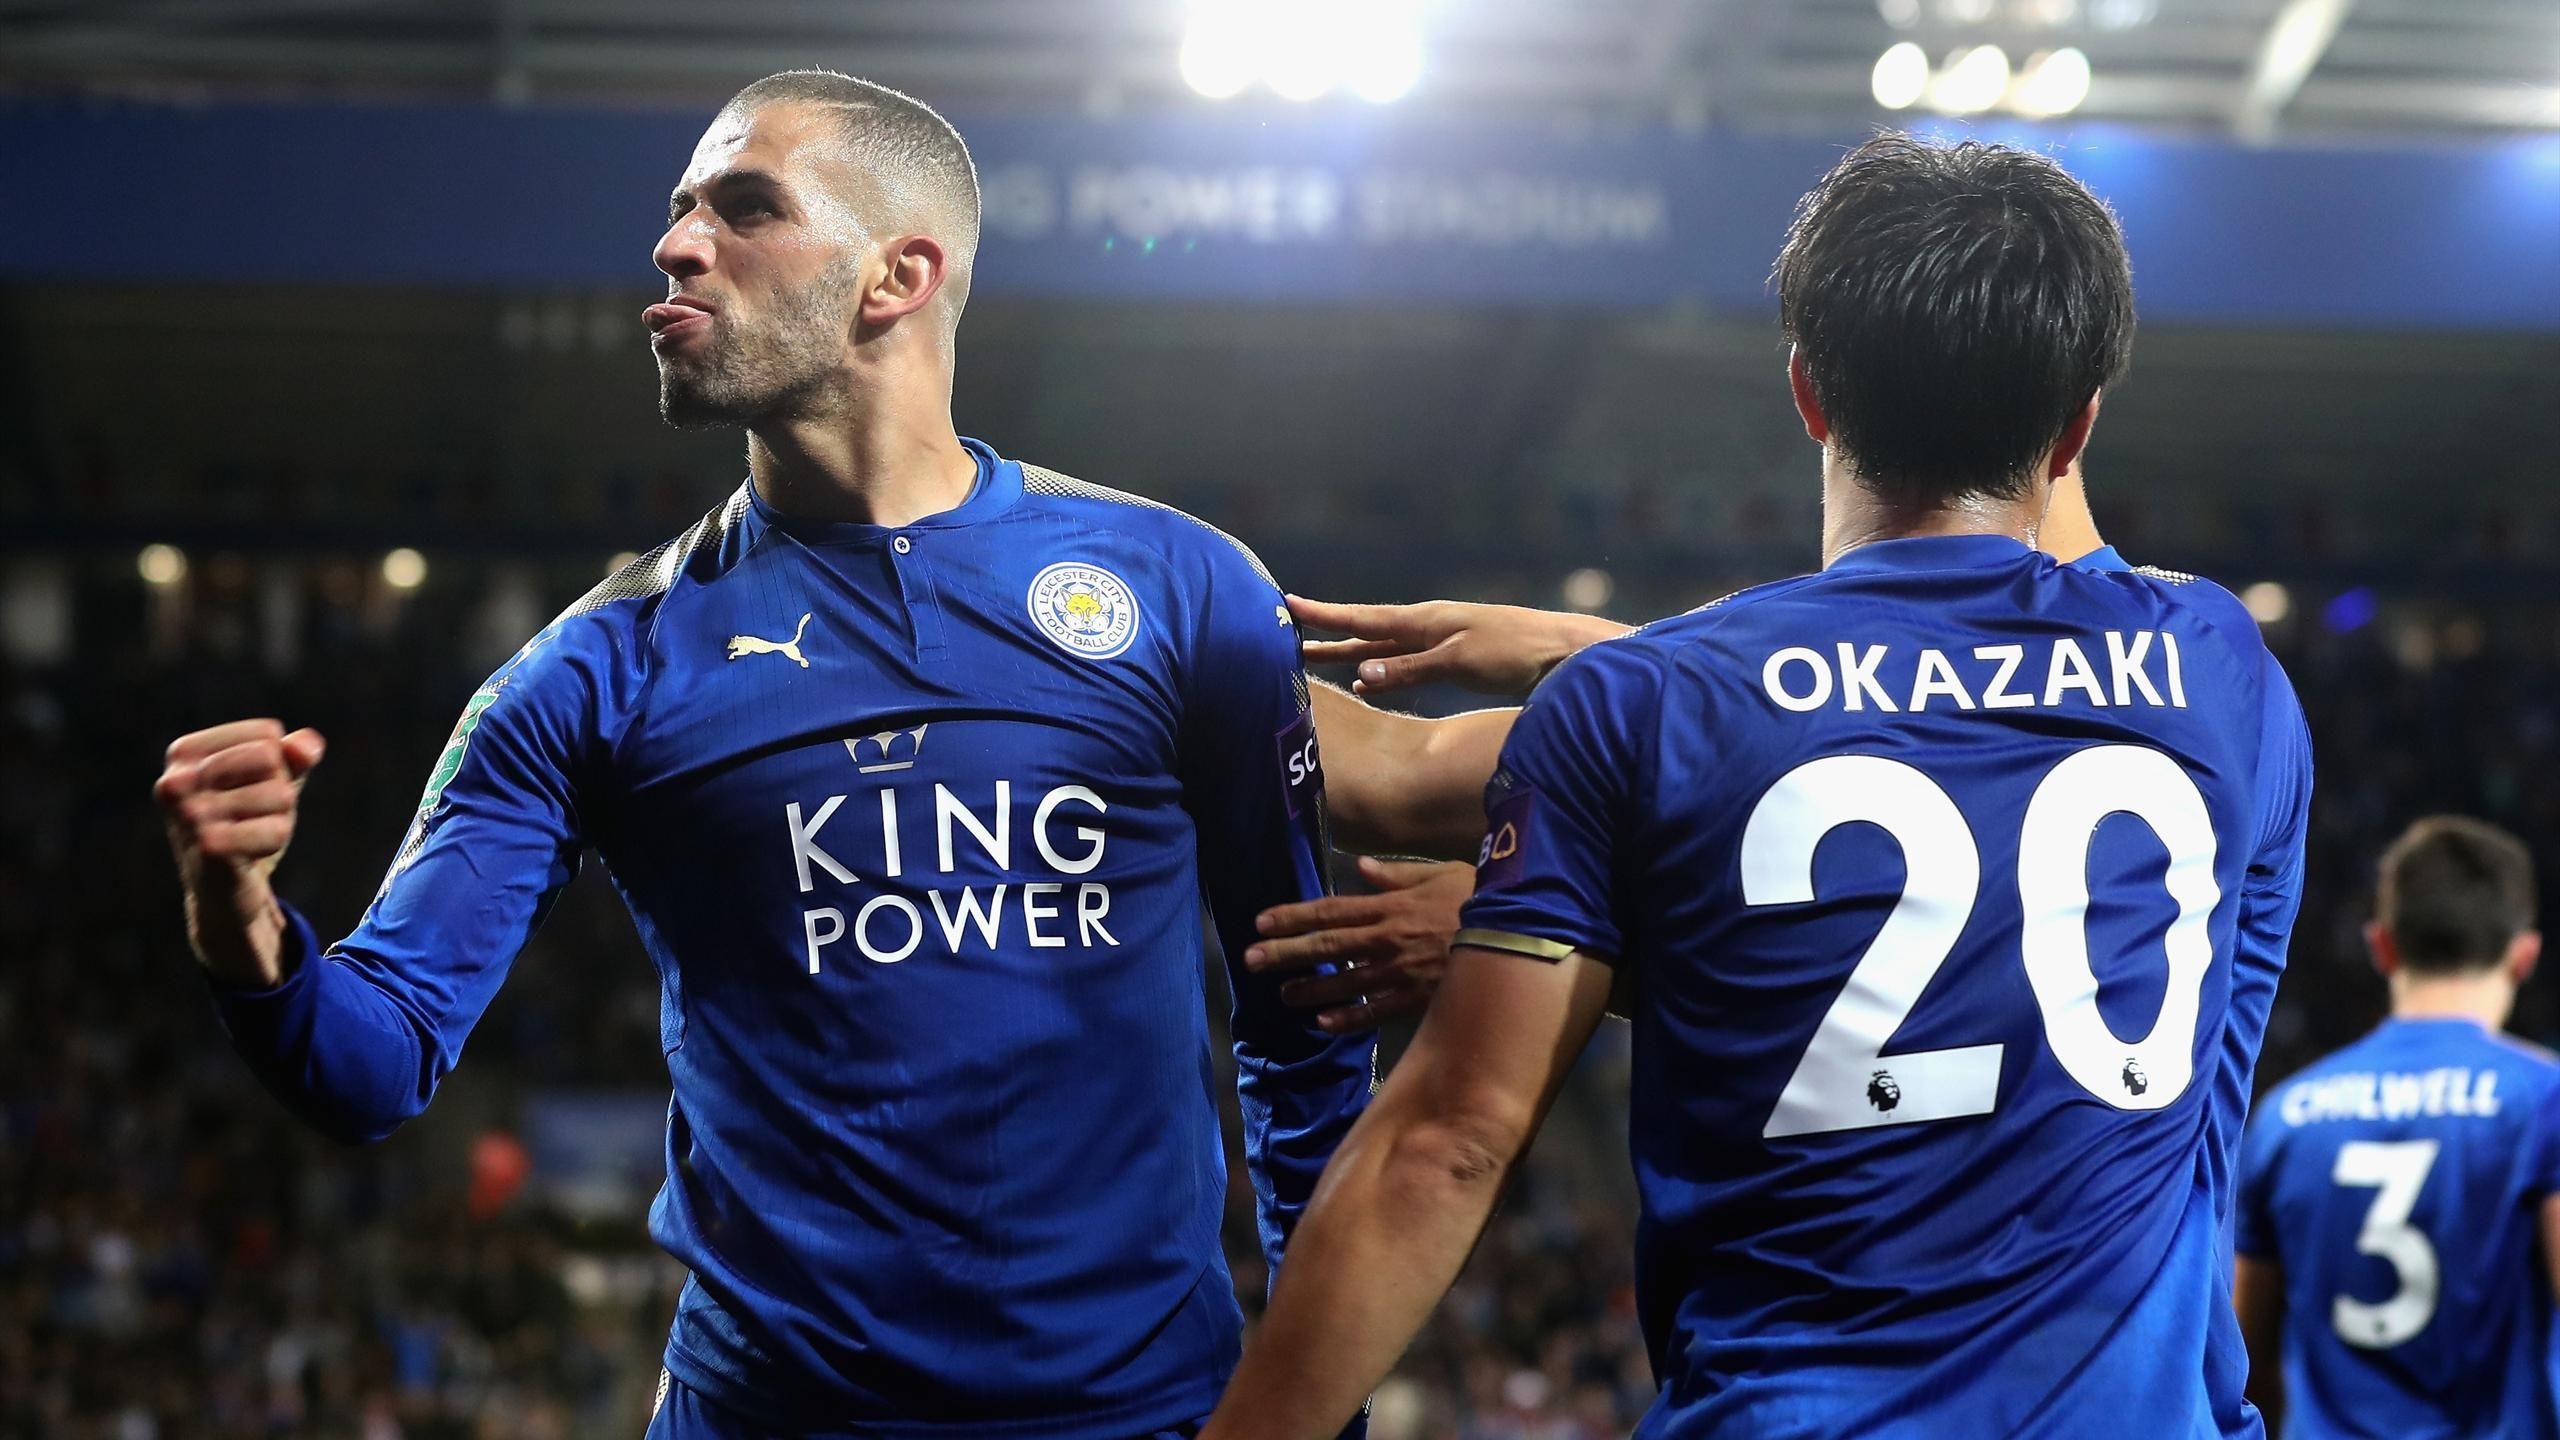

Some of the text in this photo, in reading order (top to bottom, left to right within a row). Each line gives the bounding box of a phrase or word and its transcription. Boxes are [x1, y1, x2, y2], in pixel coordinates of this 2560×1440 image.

[1039, 570, 1126, 606] LEICESTER CITY
[1041, 611, 1128, 648] FOOTBALL CLUB
[1762, 630, 2187, 713] OKAZAKI
[785, 780, 1108, 892] KING
[803, 882, 1121, 975] POWER
[1740, 743, 2222, 1139] 20
[2332, 1139, 2441, 1350] 3
